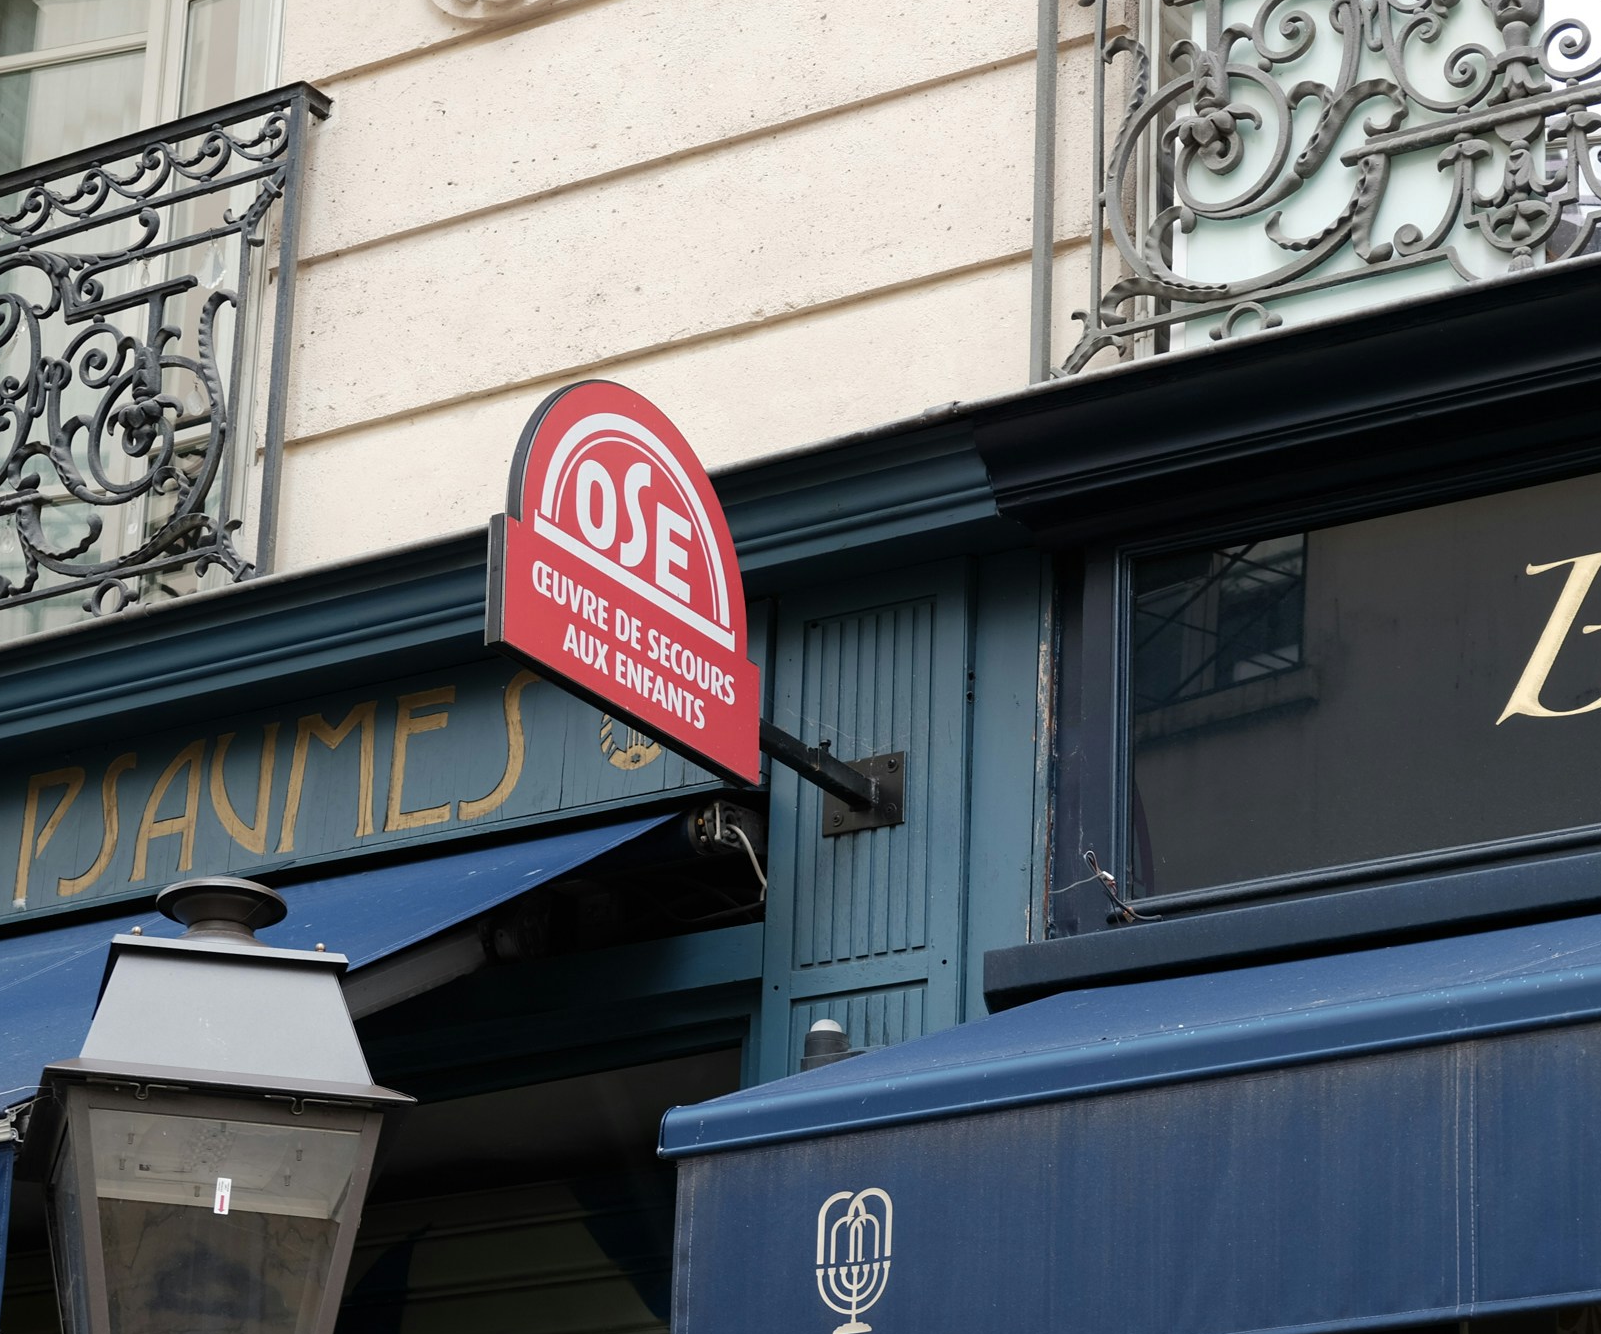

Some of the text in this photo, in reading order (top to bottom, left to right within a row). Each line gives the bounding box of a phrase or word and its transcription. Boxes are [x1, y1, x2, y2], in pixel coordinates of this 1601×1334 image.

[575, 459, 692, 604] OSE
[532, 560, 736, 706] ŒUVRE DE SECOURS
[562, 623, 706, 730] AUX ENFANTS
[13, 669, 543, 911] PSAUMES
